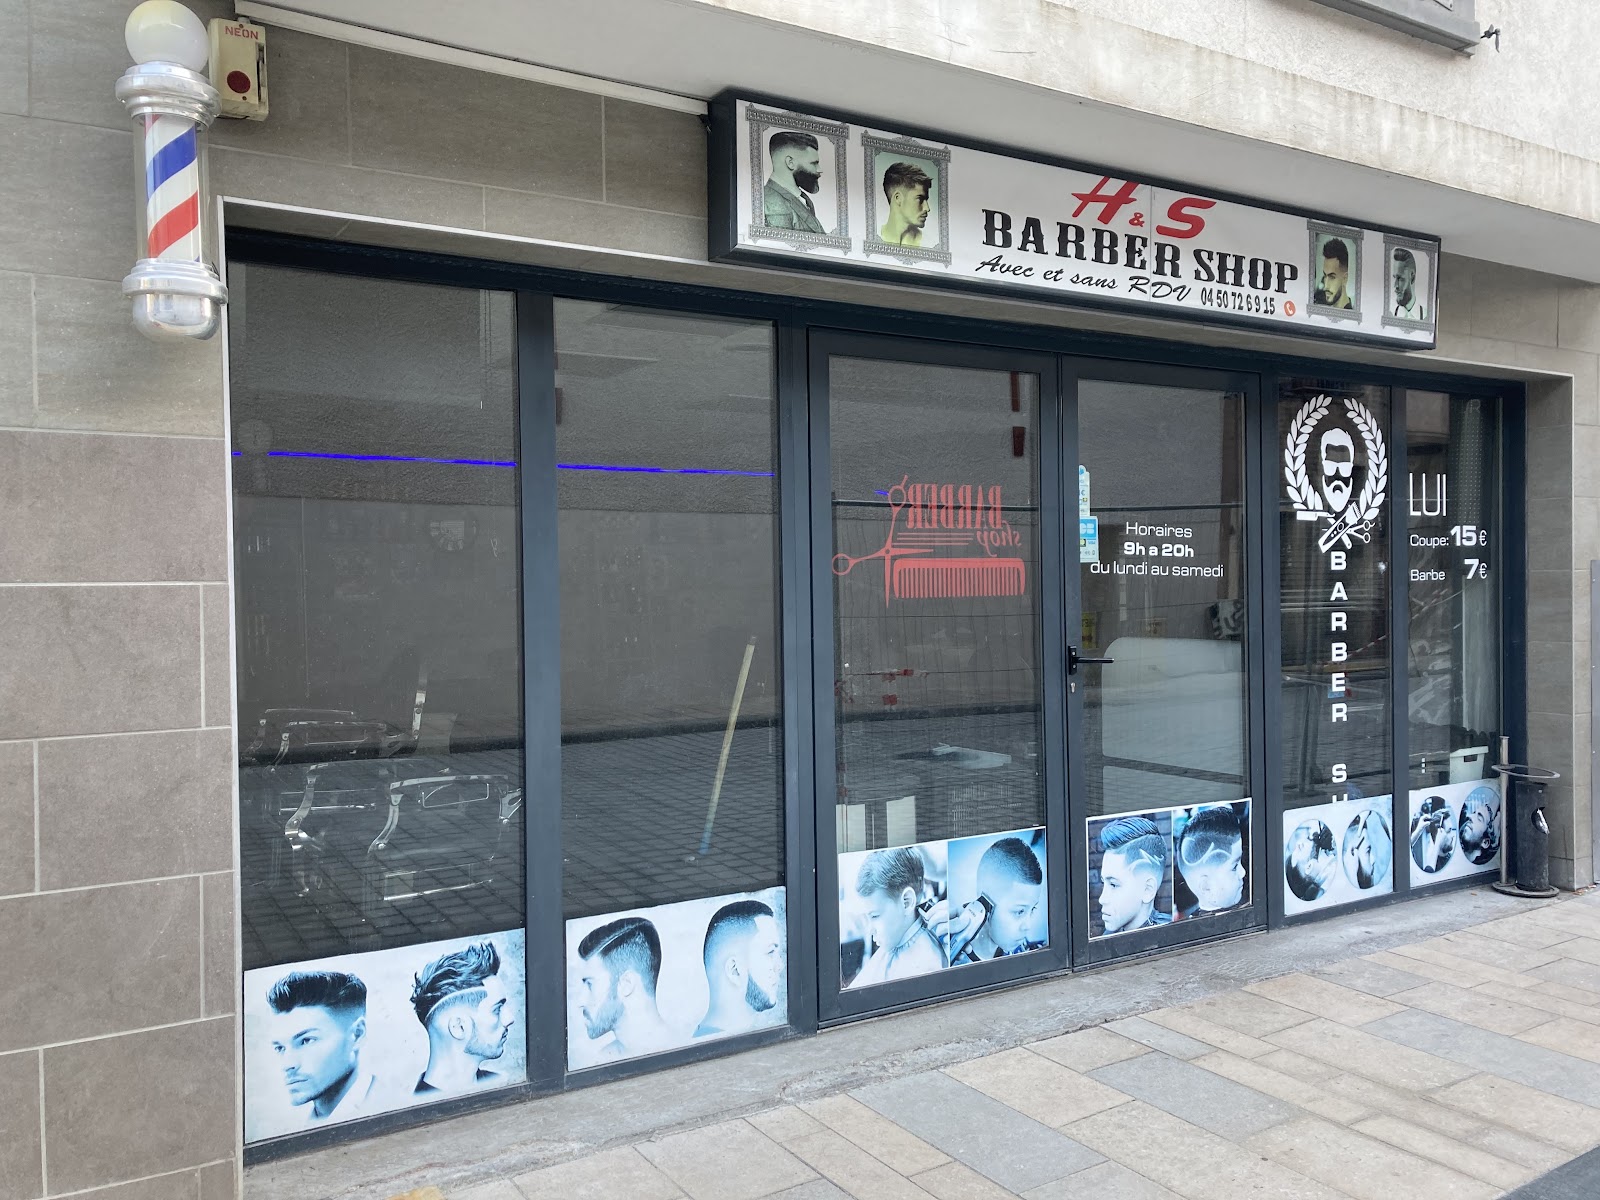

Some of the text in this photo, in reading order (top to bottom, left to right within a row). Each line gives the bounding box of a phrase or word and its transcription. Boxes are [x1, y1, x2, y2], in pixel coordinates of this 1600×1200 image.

[225, 25, 259, 40] NEON
[982, 208, 1299, 294] BARBER SHOP
[975, 254, 1192, 302] Avec et sans RDV
[1200, 286, 1214, 307] 04
[1216, 289, 1229, 309] 50
[1231, 291, 1244, 311] 72
[1263, 296, 1276, 315] 15
[1409, 472, 1447, 516] LUI
[1125, 521, 1193, 538] Horaires
[1123, 541, 1195, 558] 9h a 20h
[1409, 534, 1449, 548] Coupe:
[1090, 560, 1224, 577] du lundi au samedi
[1410, 569, 1446, 581] Barbe
[1330, 551, 1348, 723] BARBER
